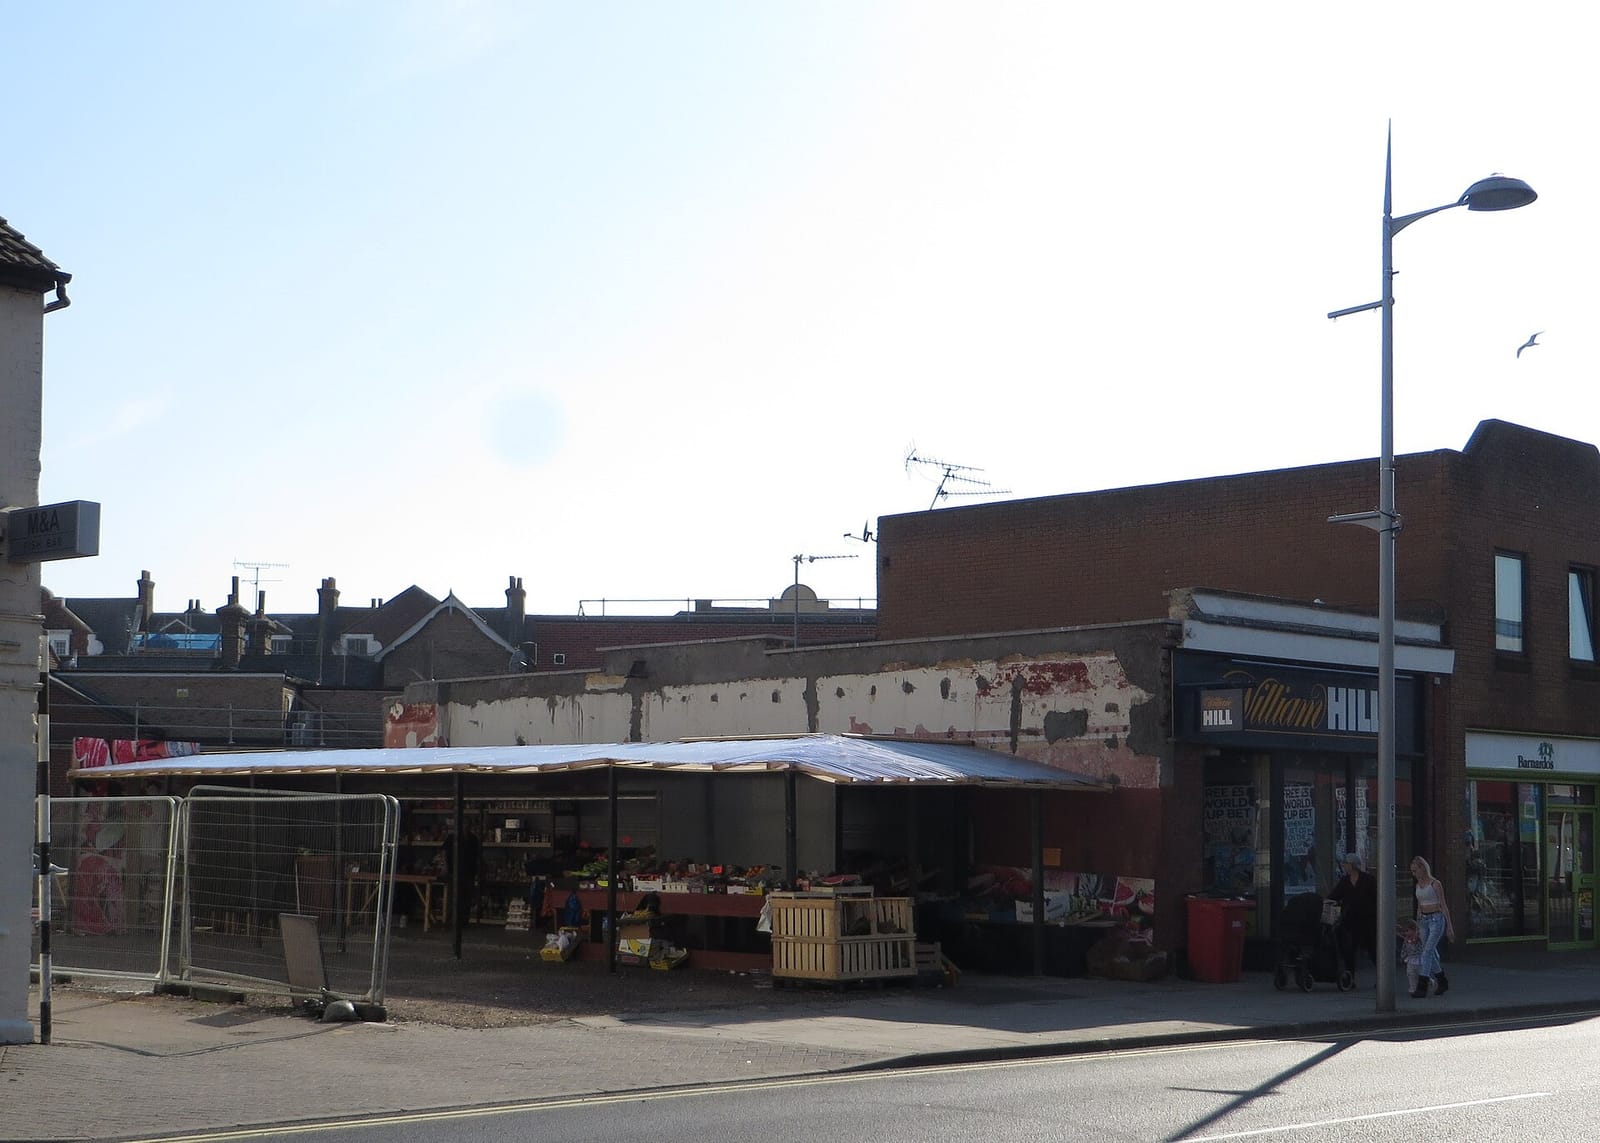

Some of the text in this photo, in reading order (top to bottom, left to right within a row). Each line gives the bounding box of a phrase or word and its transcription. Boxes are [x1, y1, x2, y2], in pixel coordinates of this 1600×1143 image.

[27, 509, 60, 535] M&A
[1202, 710, 1233, 726] HILL
[1284, 798, 1311, 809] WORLD
[1227, 808, 1249, 818] BET
[1299, 808, 1313, 819] BET
